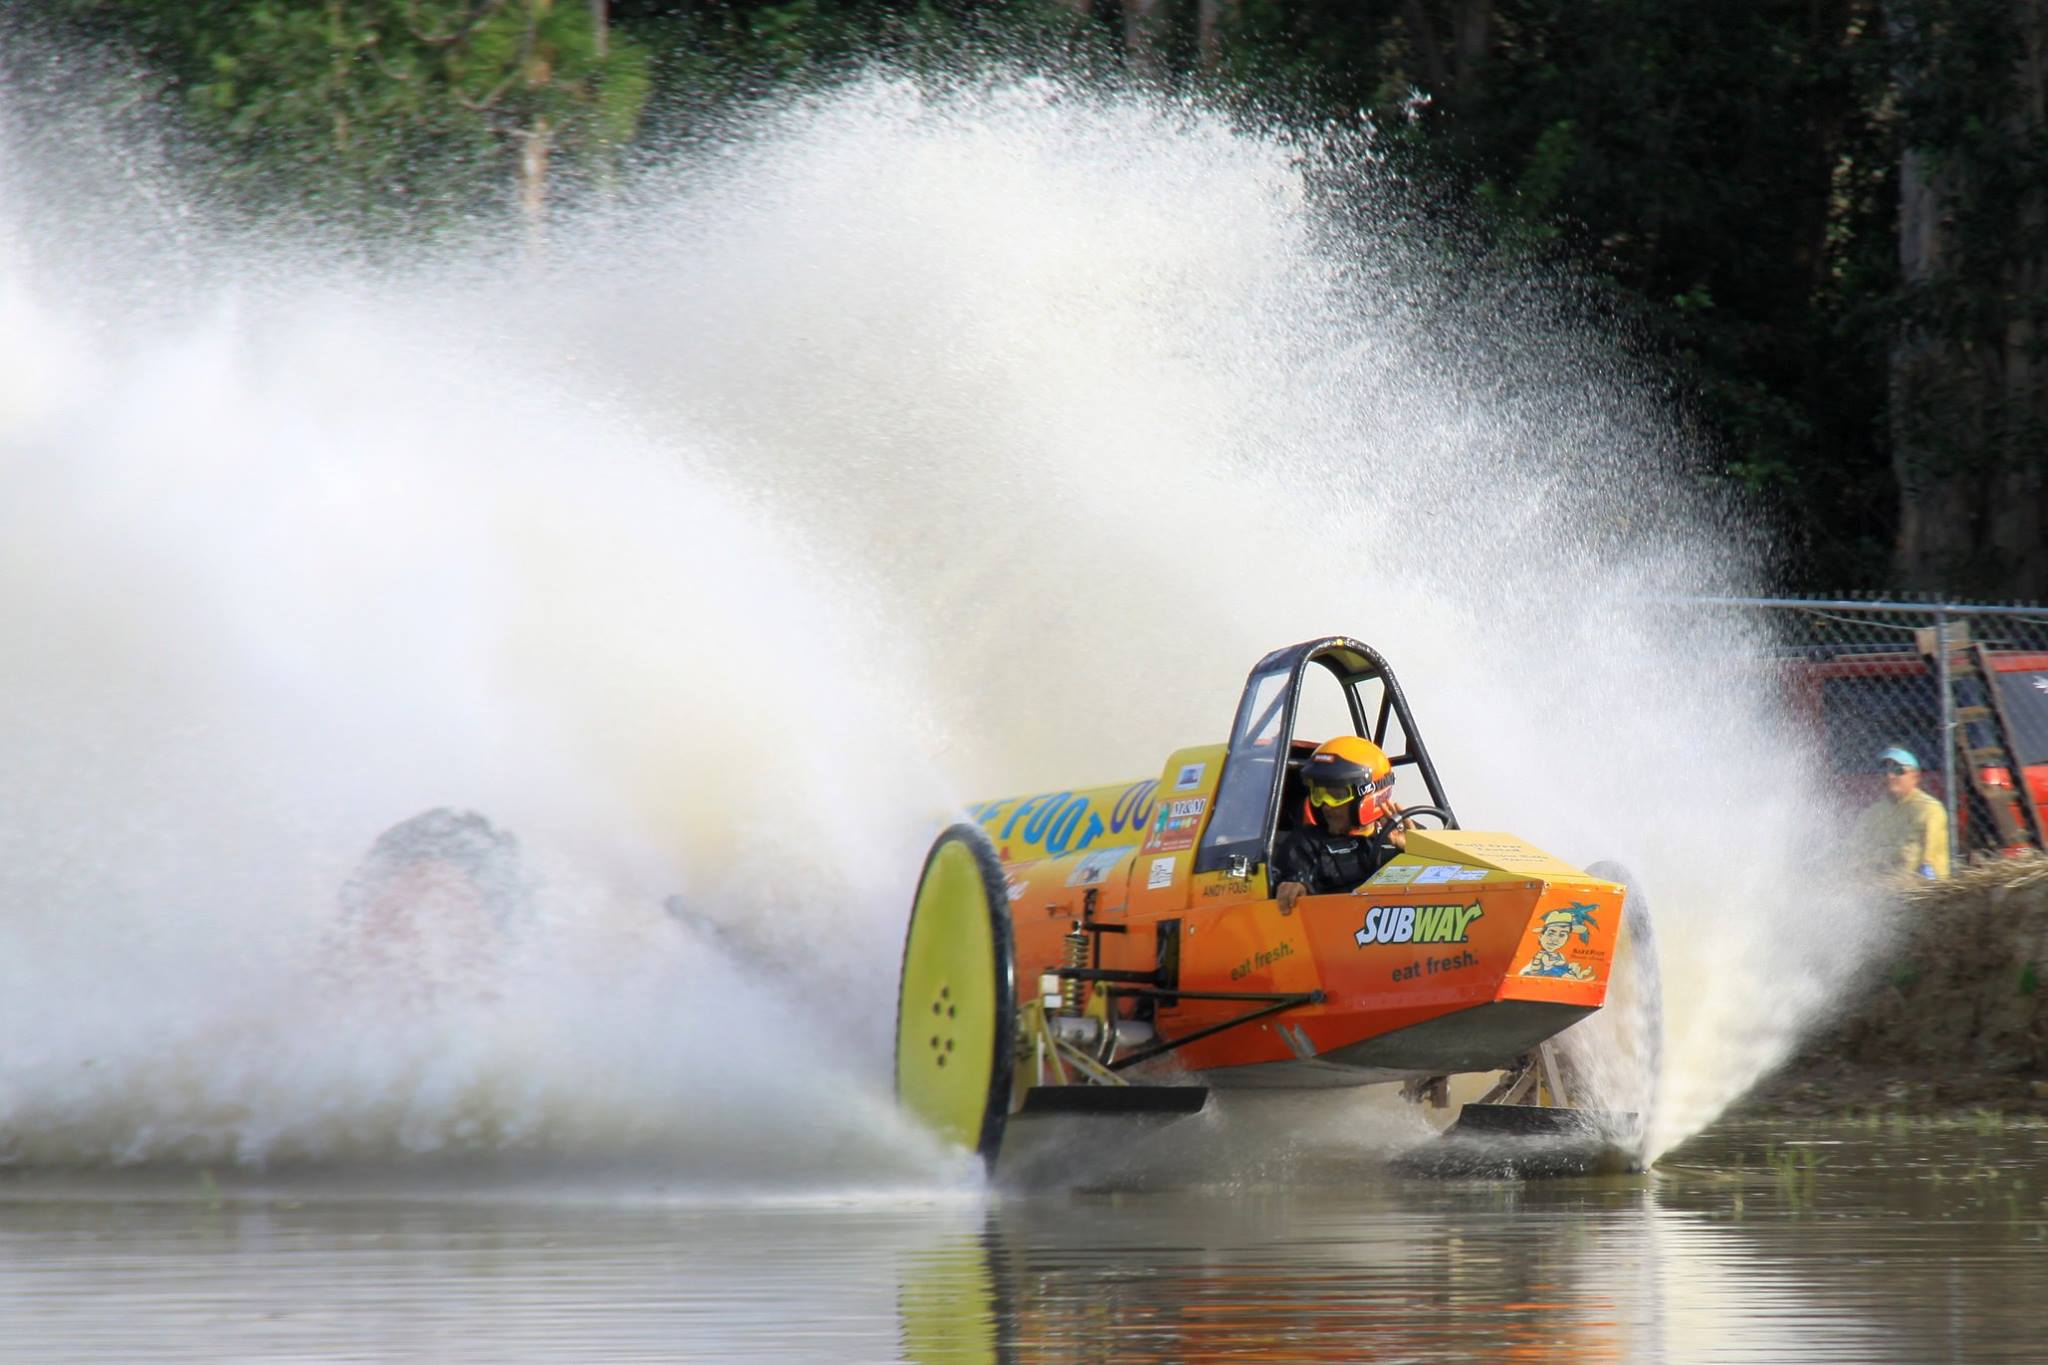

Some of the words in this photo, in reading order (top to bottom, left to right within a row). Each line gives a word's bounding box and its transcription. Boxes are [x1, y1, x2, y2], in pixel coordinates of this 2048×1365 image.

[1355, 900, 1484, 947] SUBWAY
[1231, 959, 1252, 981] eat
[1392, 961, 1421, 982] eat
